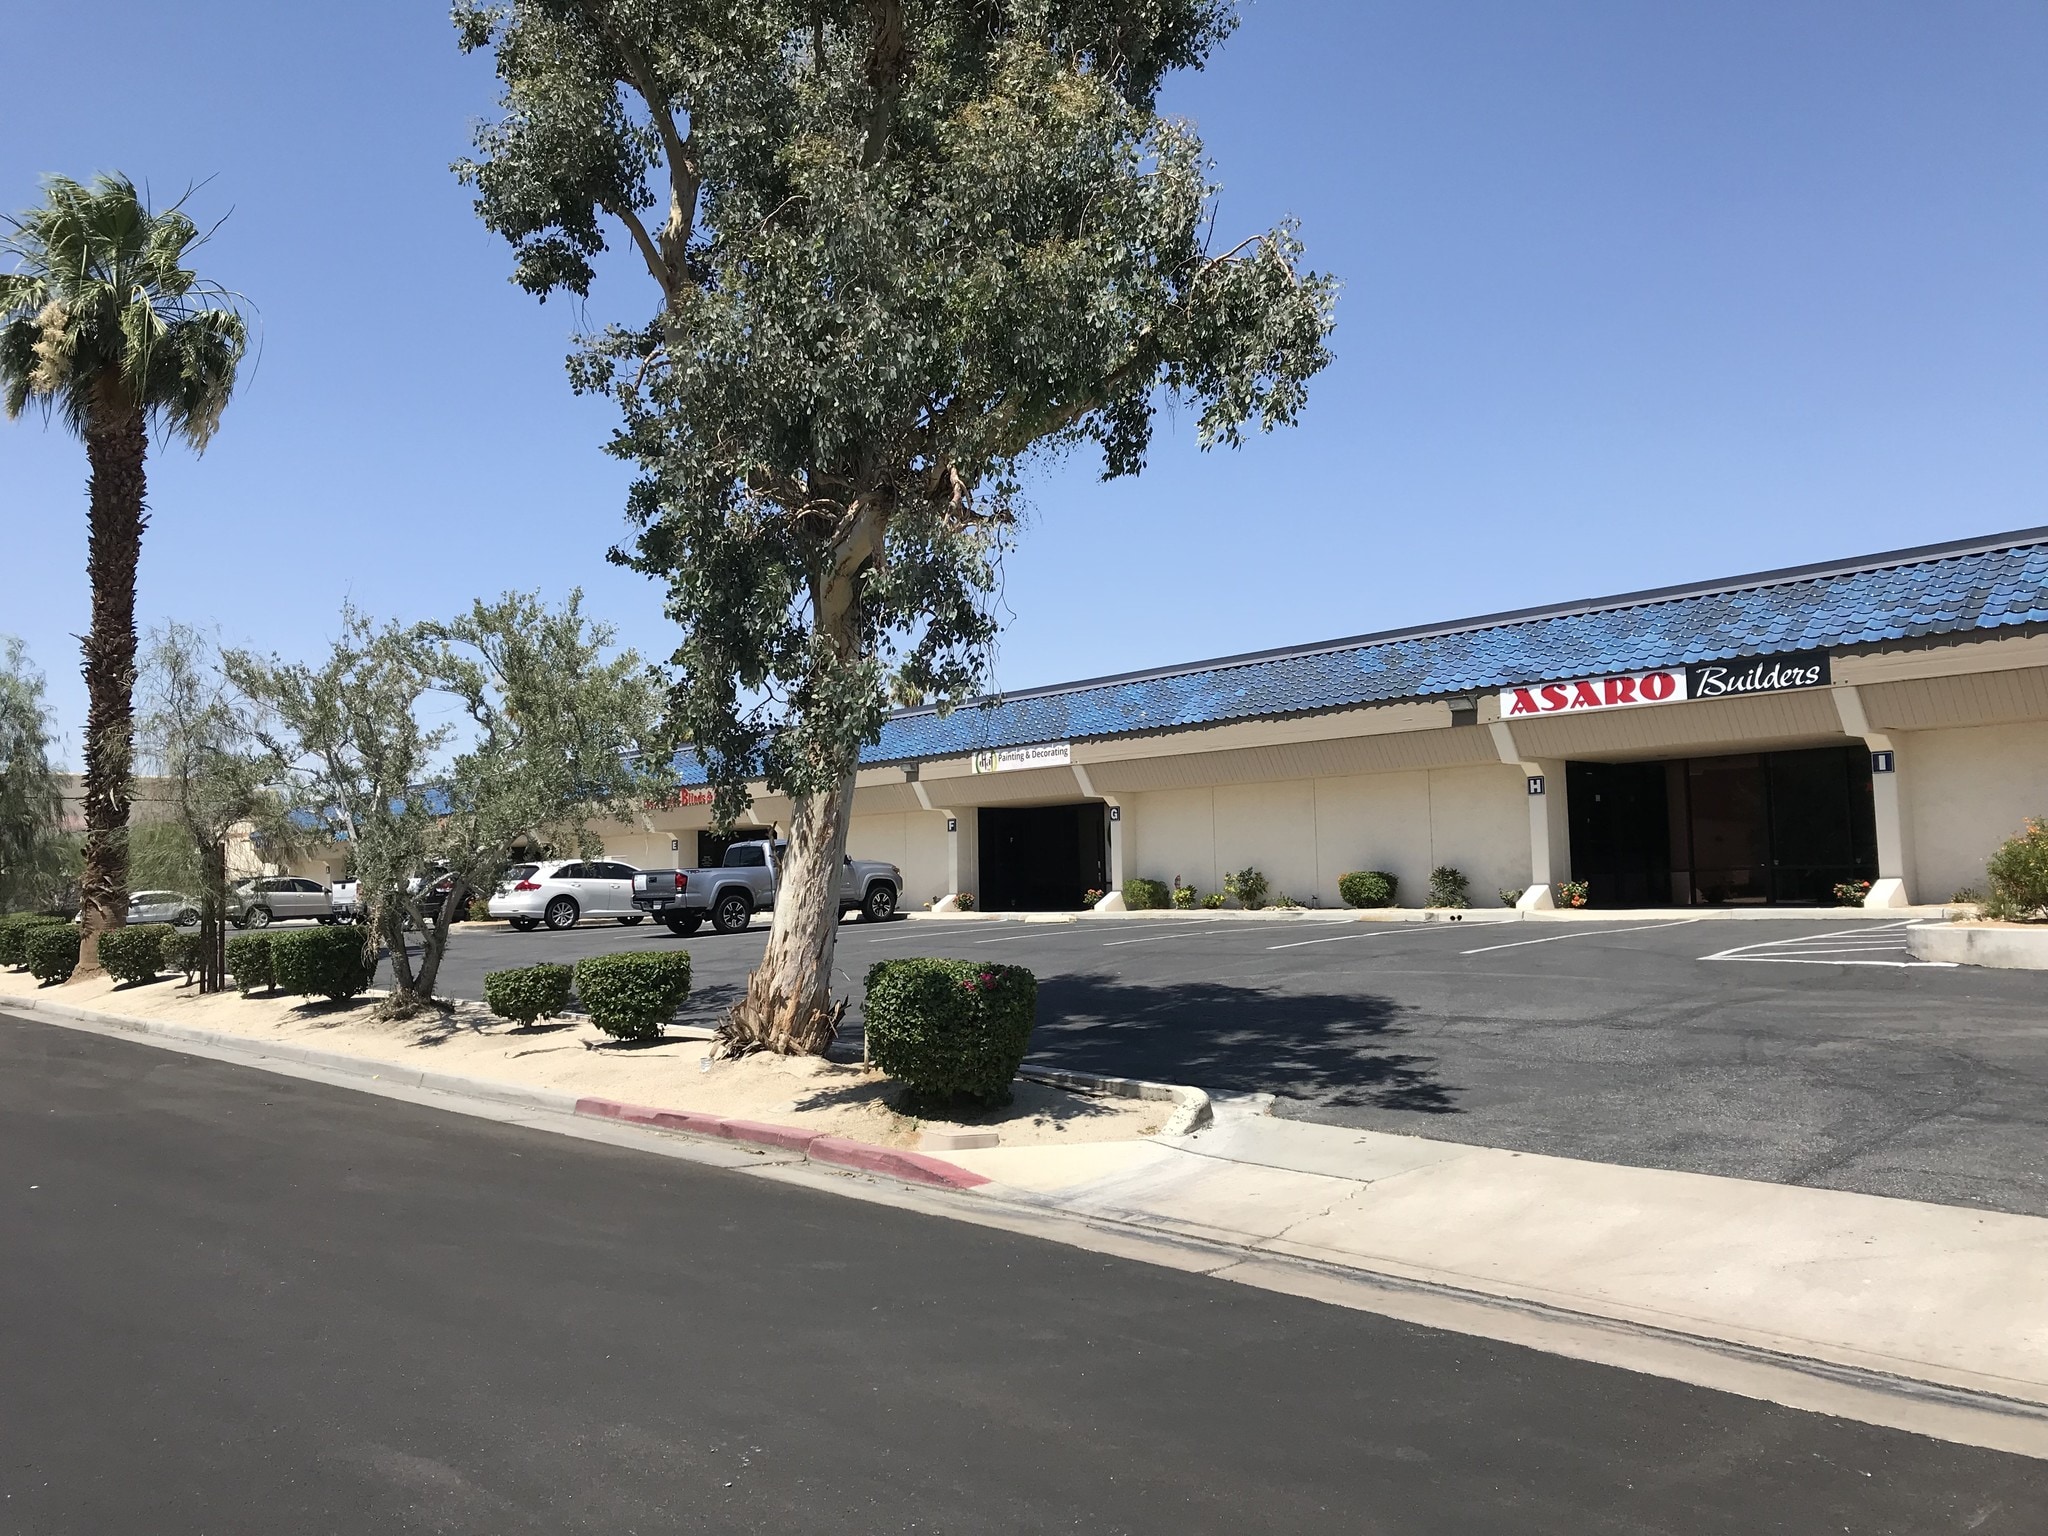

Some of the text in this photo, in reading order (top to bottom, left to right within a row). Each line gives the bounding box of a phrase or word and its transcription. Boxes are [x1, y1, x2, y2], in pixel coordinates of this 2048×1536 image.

[1509, 662, 1820, 715] ASARO Builders
[998, 752, 1025, 762] Painting
[1031, 747, 1069, 759] Decorating
[1529, 779, 1542, 793] H
